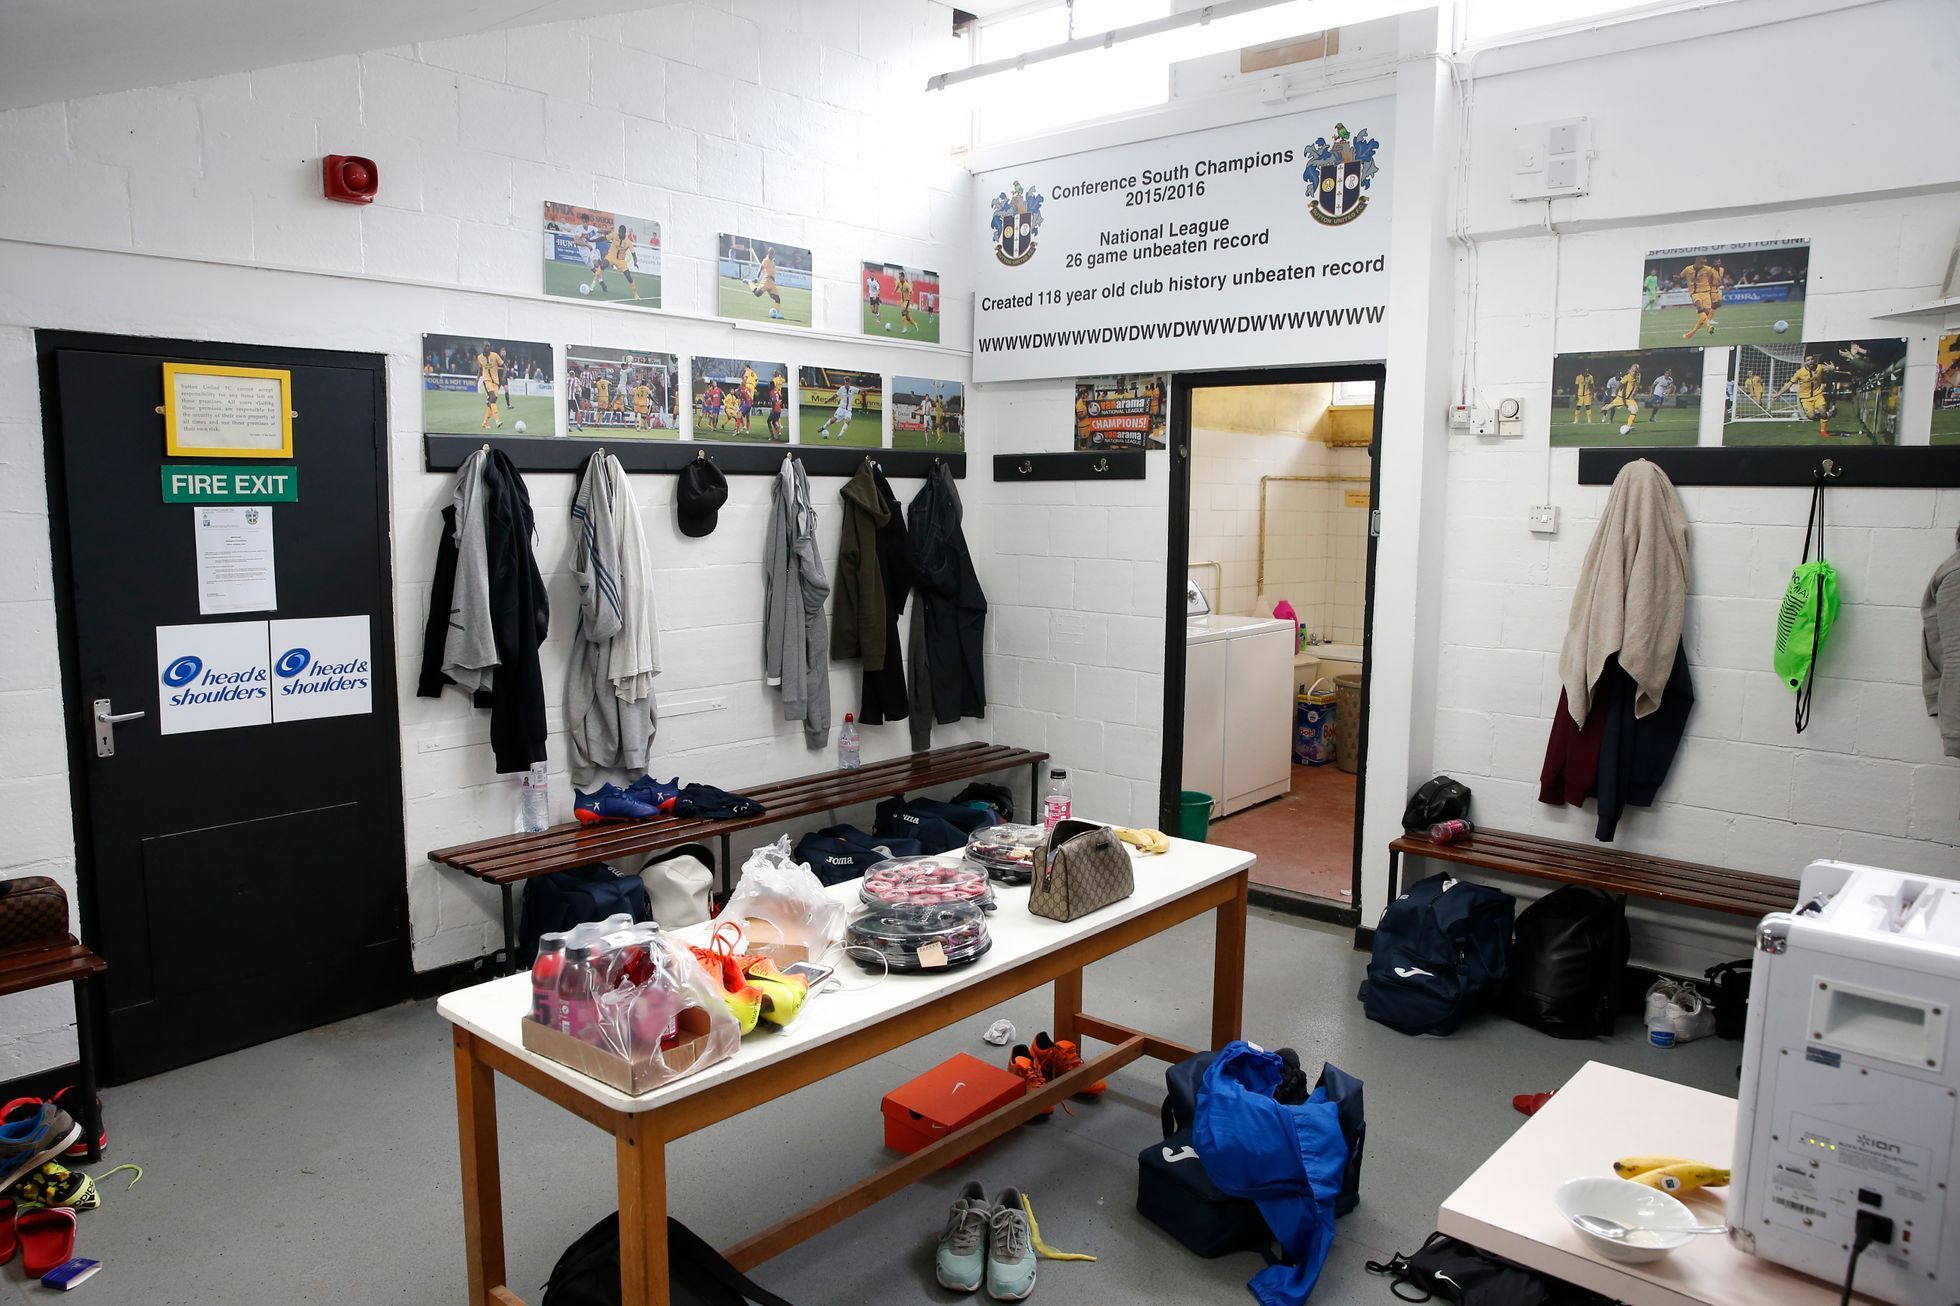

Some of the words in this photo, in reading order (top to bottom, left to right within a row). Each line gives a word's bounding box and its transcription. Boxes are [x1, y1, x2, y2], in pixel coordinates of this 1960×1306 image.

[1051, 173, 1137, 201] Conference
[1142, 165, 1190, 187] South
[1195, 147, 1294, 180] Champions
[1126, 181, 1206, 207] 2015/2016
[1099, 221, 1164, 247] National
[1169, 215, 1230, 244] League
[1066, 252, 1083, 268] 26
[1087, 245, 1129, 270] game
[1133, 236, 1208, 260] unbeaten
[1213, 229, 1269, 250] record
[982, 292, 1033, 311] Created
[1037, 289, 1062, 306] 118
[1066, 285, 1097, 307] year
[1102, 281, 1125, 299] old
[1130, 278, 1164, 296] club
[1168, 271, 1227, 295] history
[1232, 263, 1316, 286] unbeaten
[1321, 255, 1385, 276] record
[979, 305, 1385, 353] WWWWDWWWWDWDWWDWWWDWWWWWWW
[1092, 418, 1147, 429] CHAMPIONS!
[171, 474, 229, 495] FIRE
[235, 474, 289, 494] EXIT
[169, 684, 267, 706] shoulders
[281, 676, 368, 696] shoulders
